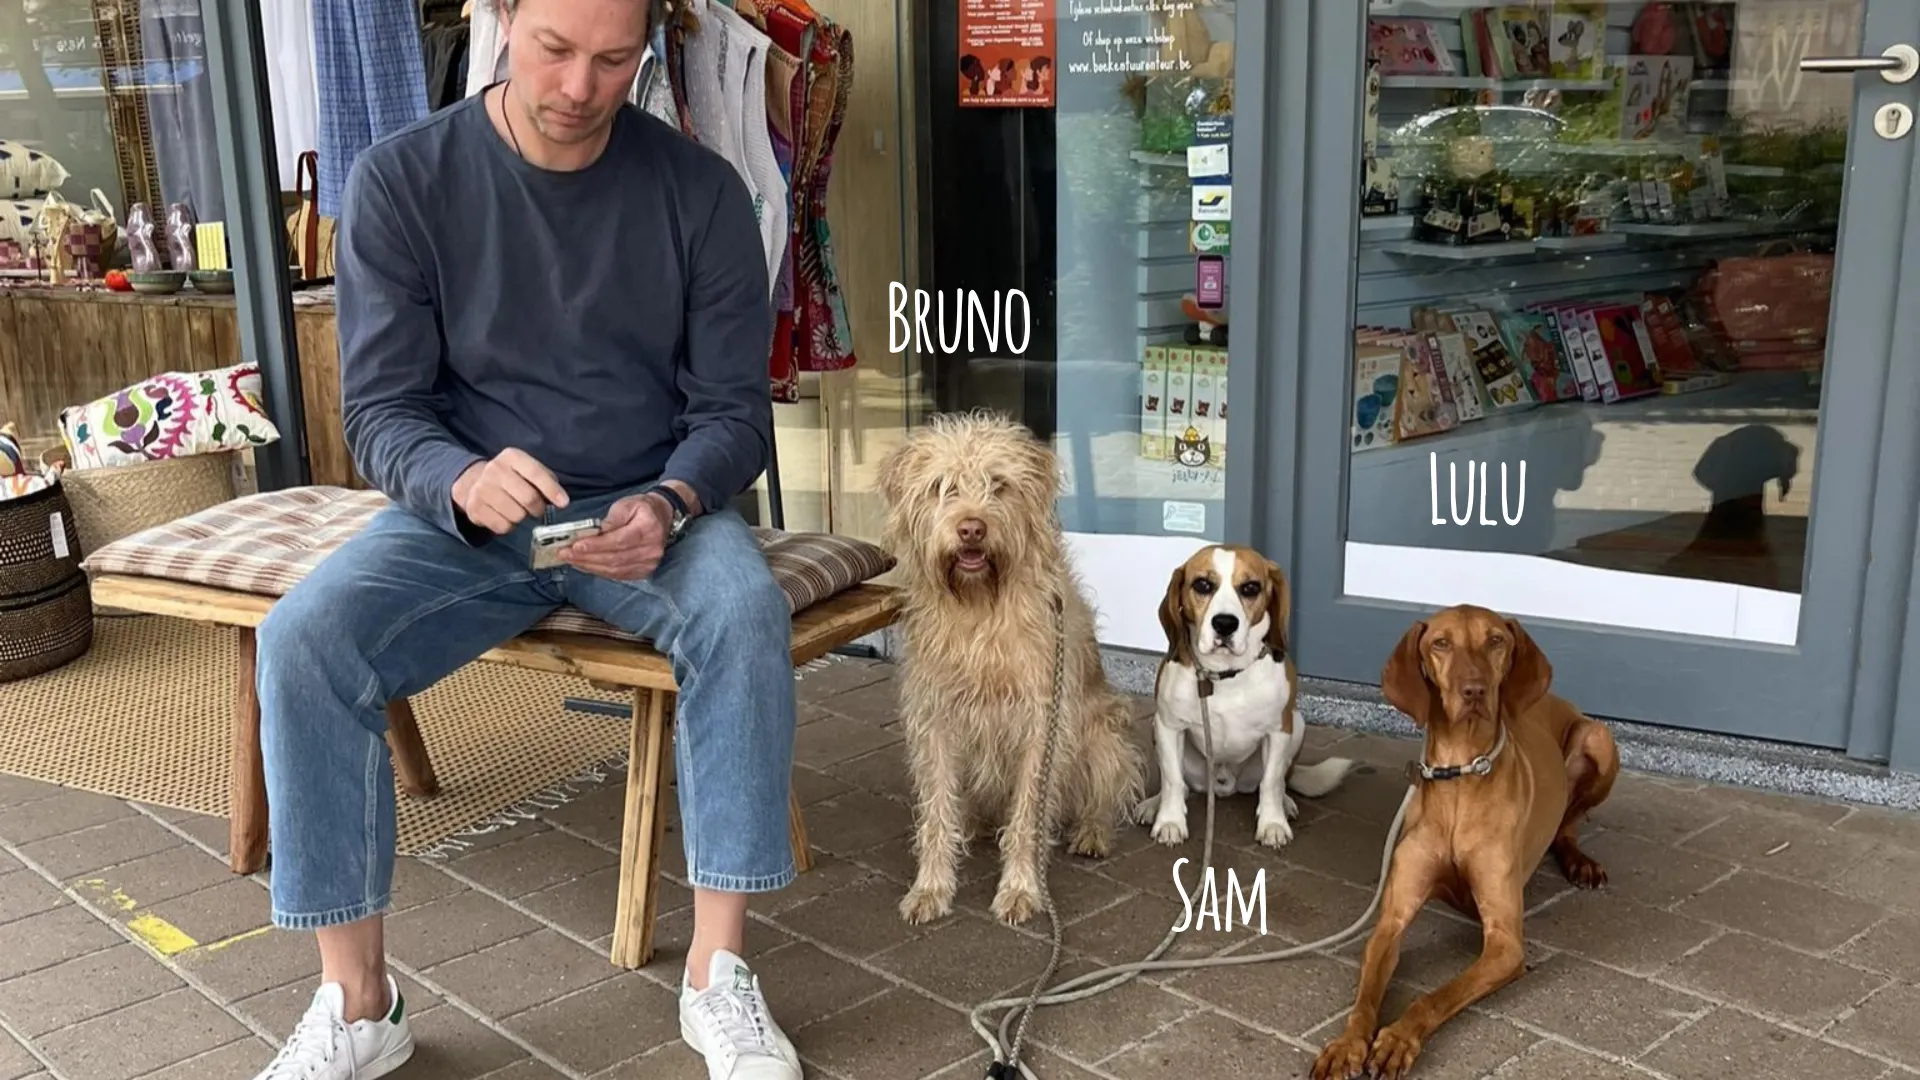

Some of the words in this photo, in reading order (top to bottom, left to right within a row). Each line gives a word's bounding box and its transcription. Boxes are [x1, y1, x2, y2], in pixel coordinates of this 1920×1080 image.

[1177, 2, 1194, 19] open
[1082, 30, 1094, 47] Of
[1095, 28, 1111, 54] shop
[1114, 37, 1123, 53] op
[1125, 36, 1142, 45] onze
[1145, 26, 1176, 52] webshop
